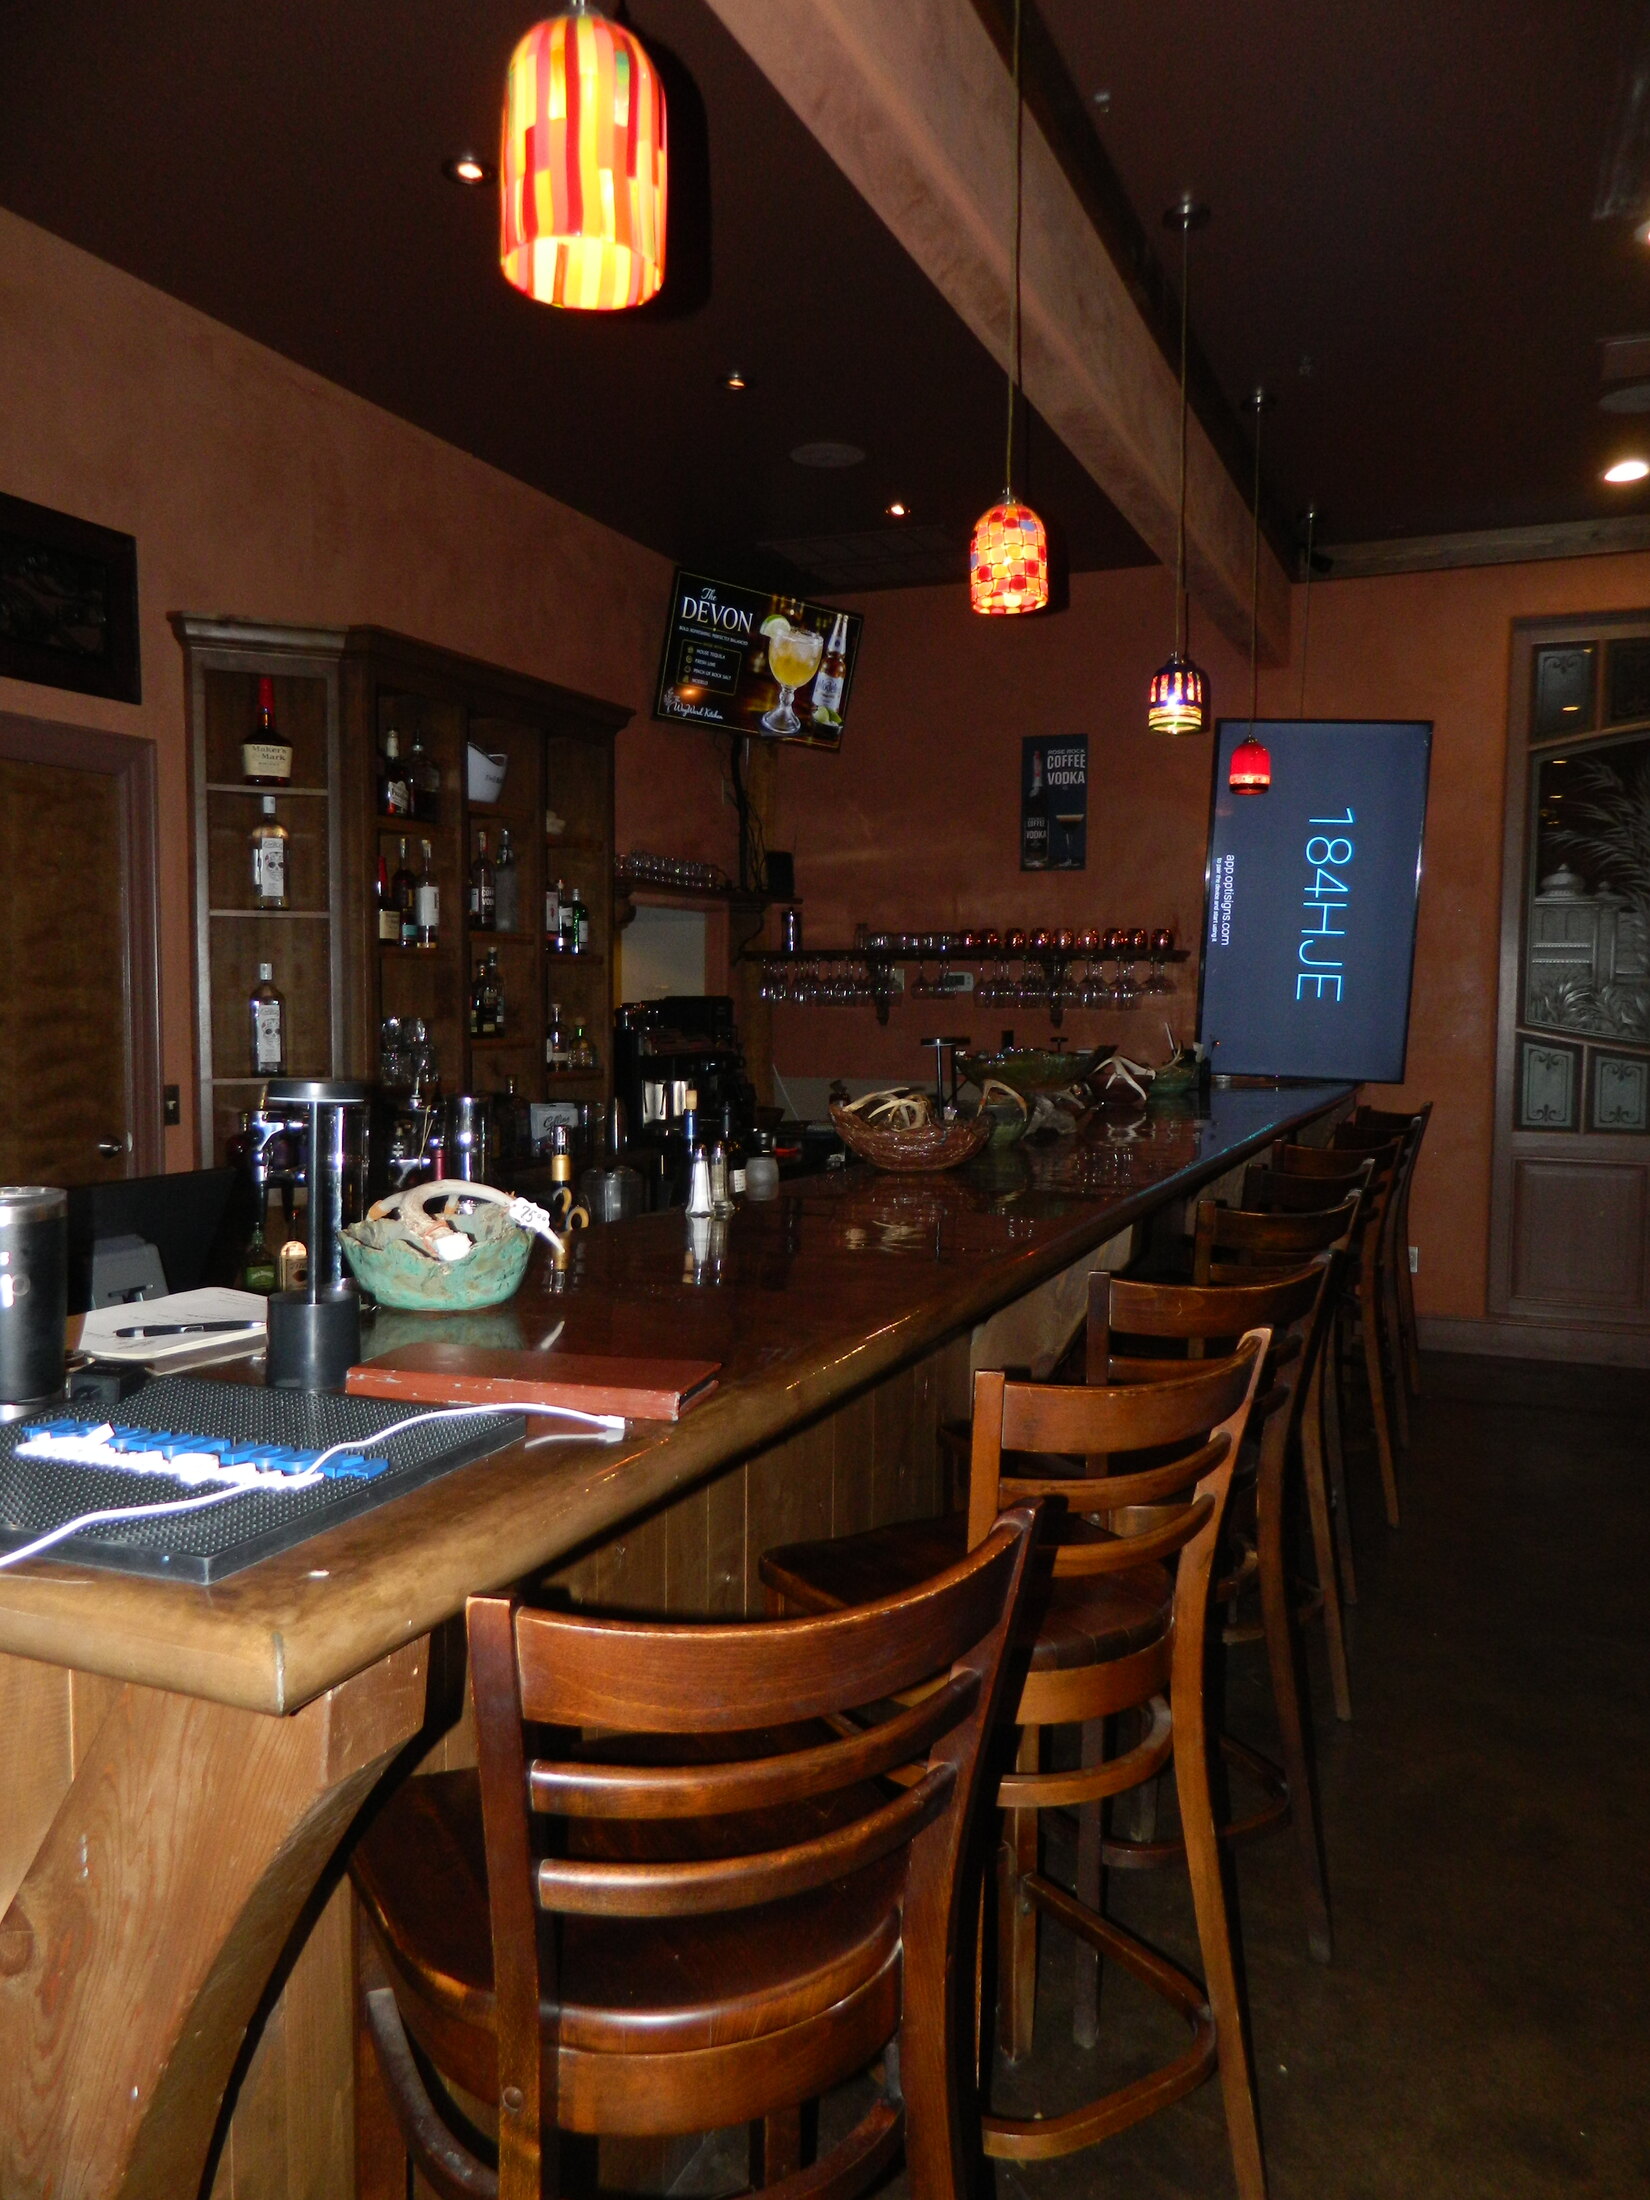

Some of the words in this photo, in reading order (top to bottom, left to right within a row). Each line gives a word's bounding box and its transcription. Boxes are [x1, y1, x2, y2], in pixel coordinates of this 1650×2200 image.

[701, 588, 717, 601] The
[682, 597, 754, 634] DEVON
[696, 648, 709, 656] HOUSE
[710, 651, 726, 660] TEQUILA
[694, 658, 707, 666] FRESH
[704, 707, 724, 720] Kitchen
[252, 745, 287, 754] Maker's
[261, 753, 286, 761] Mark
[1047, 754, 1086, 770] COFFEE
[1047, 771, 1086, 786] VODKA
[1026, 830, 1047, 840] VODKA
[1221, 854, 1235, 946] app.optisigns.com
[1295, 807, 1354, 1003] 184HJE
[1210, 924, 1218, 938] using
